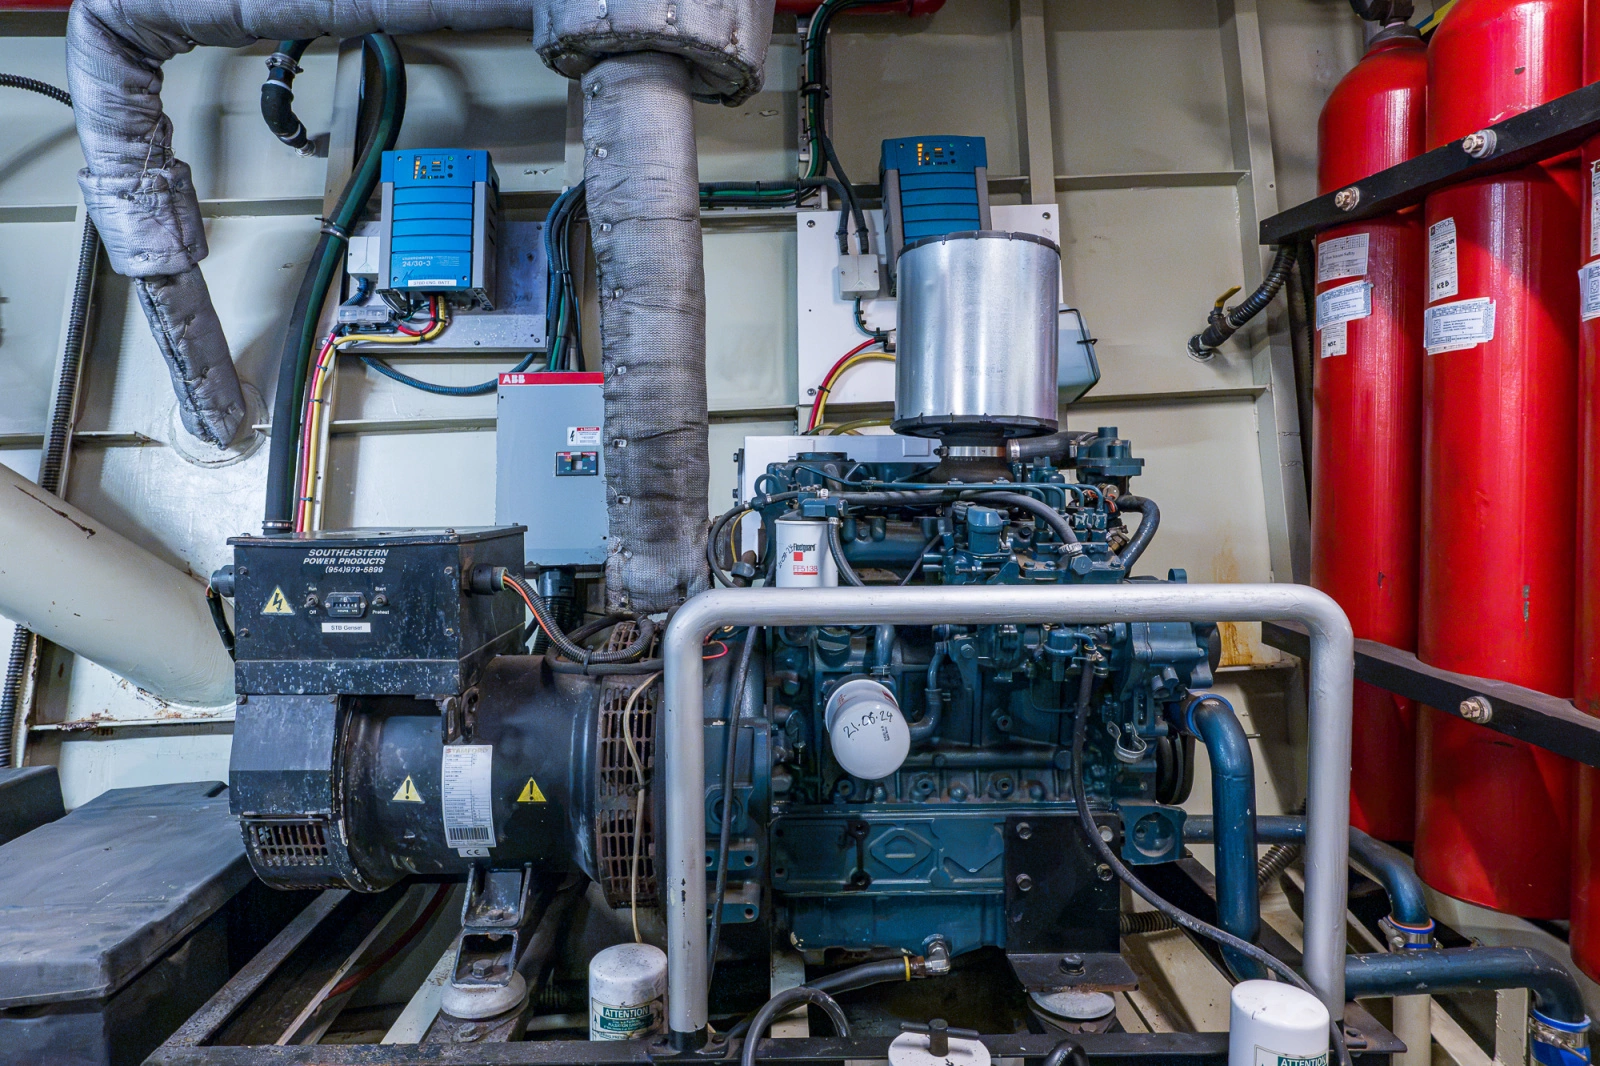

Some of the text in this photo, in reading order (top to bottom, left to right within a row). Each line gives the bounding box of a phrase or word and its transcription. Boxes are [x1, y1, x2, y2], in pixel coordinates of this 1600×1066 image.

[502, 374, 526, 384] ABB
[308, 549, 389, 557] SOUTHEASTERN
[338, 557, 386, 565] PRODUCTS
[325, 566, 384, 574] (954)979-5899
[604, 1007, 648, 1018] ATTENTION
